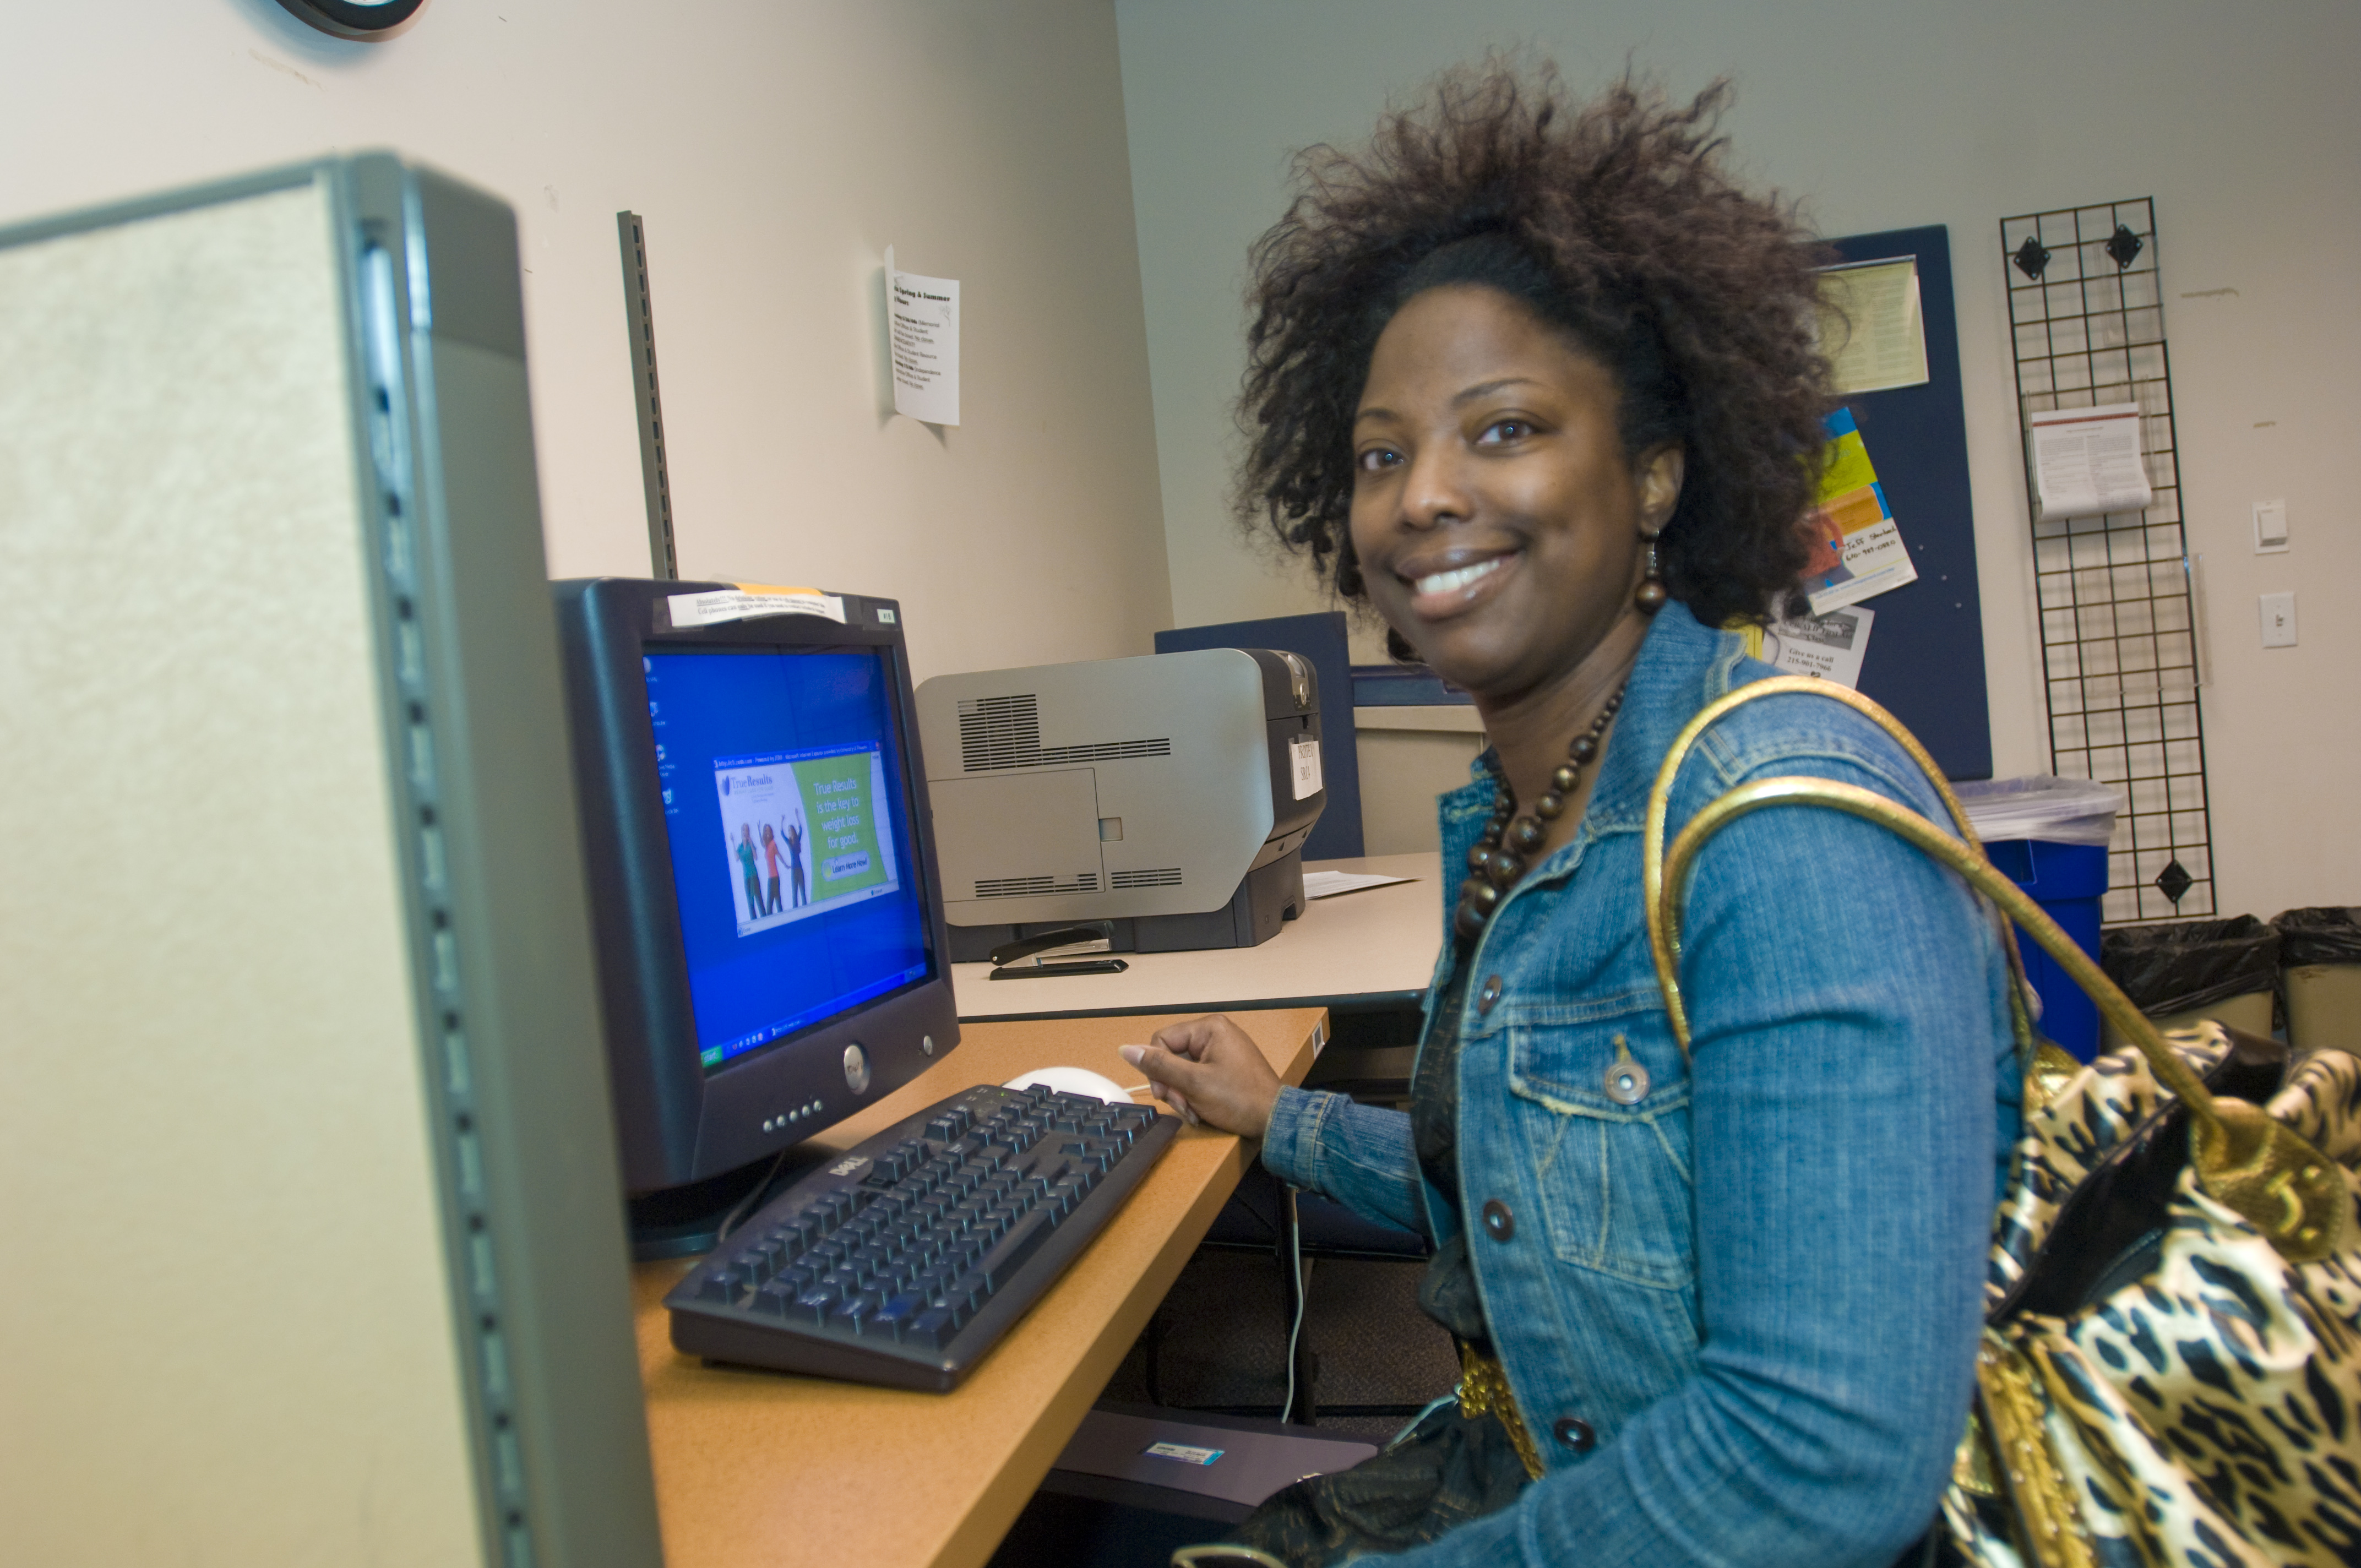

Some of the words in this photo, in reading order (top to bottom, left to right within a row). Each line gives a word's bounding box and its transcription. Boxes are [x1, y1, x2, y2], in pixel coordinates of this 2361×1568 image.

[899, 286, 916, 298] Spring
[923, 292, 950, 301] Summer
[709, 606, 727, 615] phones
[1789, 648, 1805, 656] Give
[813, 782, 831, 795] True
[832, 777, 857, 792] Results
[817, 802, 823, 814] is
[824, 800, 836, 812] the
[837, 798, 850, 811] key
[851, 797, 859, 807] to
[821, 816, 846, 832] weight
[846, 815, 859, 826] loss
[828, 836, 837, 848] for
[840, 832, 858, 849] good.
[832, 865, 845, 873] Learn
[857, 858, 868, 867] Now!
[828, 1157, 869, 1177] DELL
